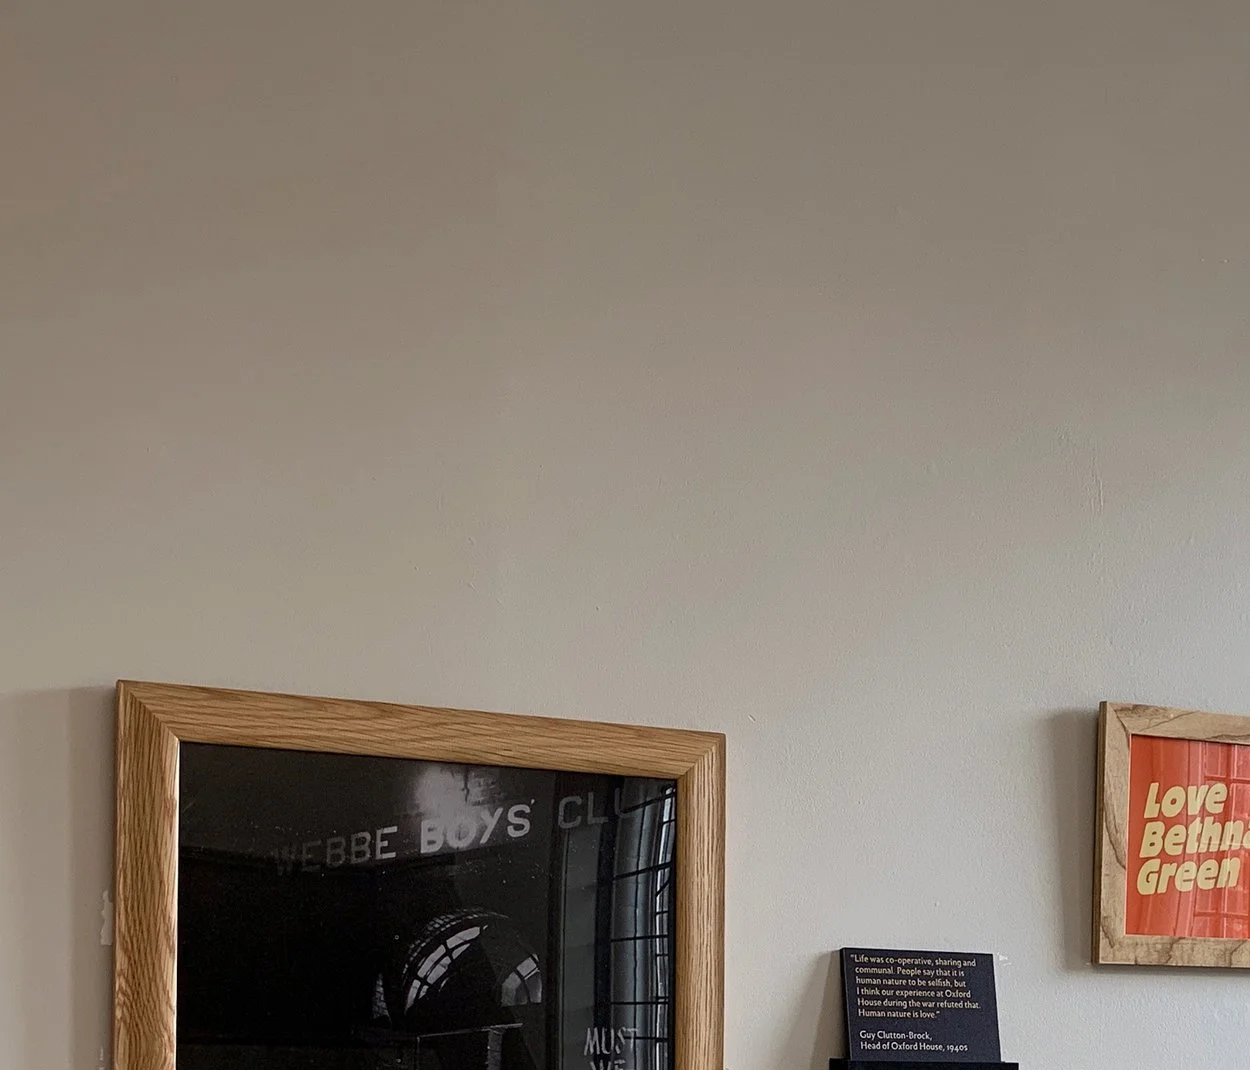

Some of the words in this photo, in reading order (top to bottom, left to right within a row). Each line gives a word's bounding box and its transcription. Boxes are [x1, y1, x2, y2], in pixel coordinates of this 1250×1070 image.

[1144, 782, 1228, 818] Love
[1136, 857, 1241, 895] Green
[935, 958, 962, 968] sharing
[963, 959, 977, 967] and
[897, 967, 922, 976] People
[922, 970, 935, 978] say
[936, 968, 951, 976] that
[856, 976, 882, 984] human
[928, 978, 953, 987] selfish,
[861, 987, 881, 995] think
[945, 989, 971, 998] Oxford
[857, 998, 882, 1006] House
[883, 999, 908, 1009] during
[908, 999, 921, 1007] the
[858, 1009, 886, 1017] Human
[887, 1008, 912, 1018] nature
[860, 1030, 876, 1040] Guy
[877, 1031, 933, 1040] Clutton-Brock,
[584, 1027, 638, 1055] MUST
[860, 1041, 881, 1050] Head
[891, 1042, 918, 1050] Oxford
[919, 1043, 945, 1052] House,
